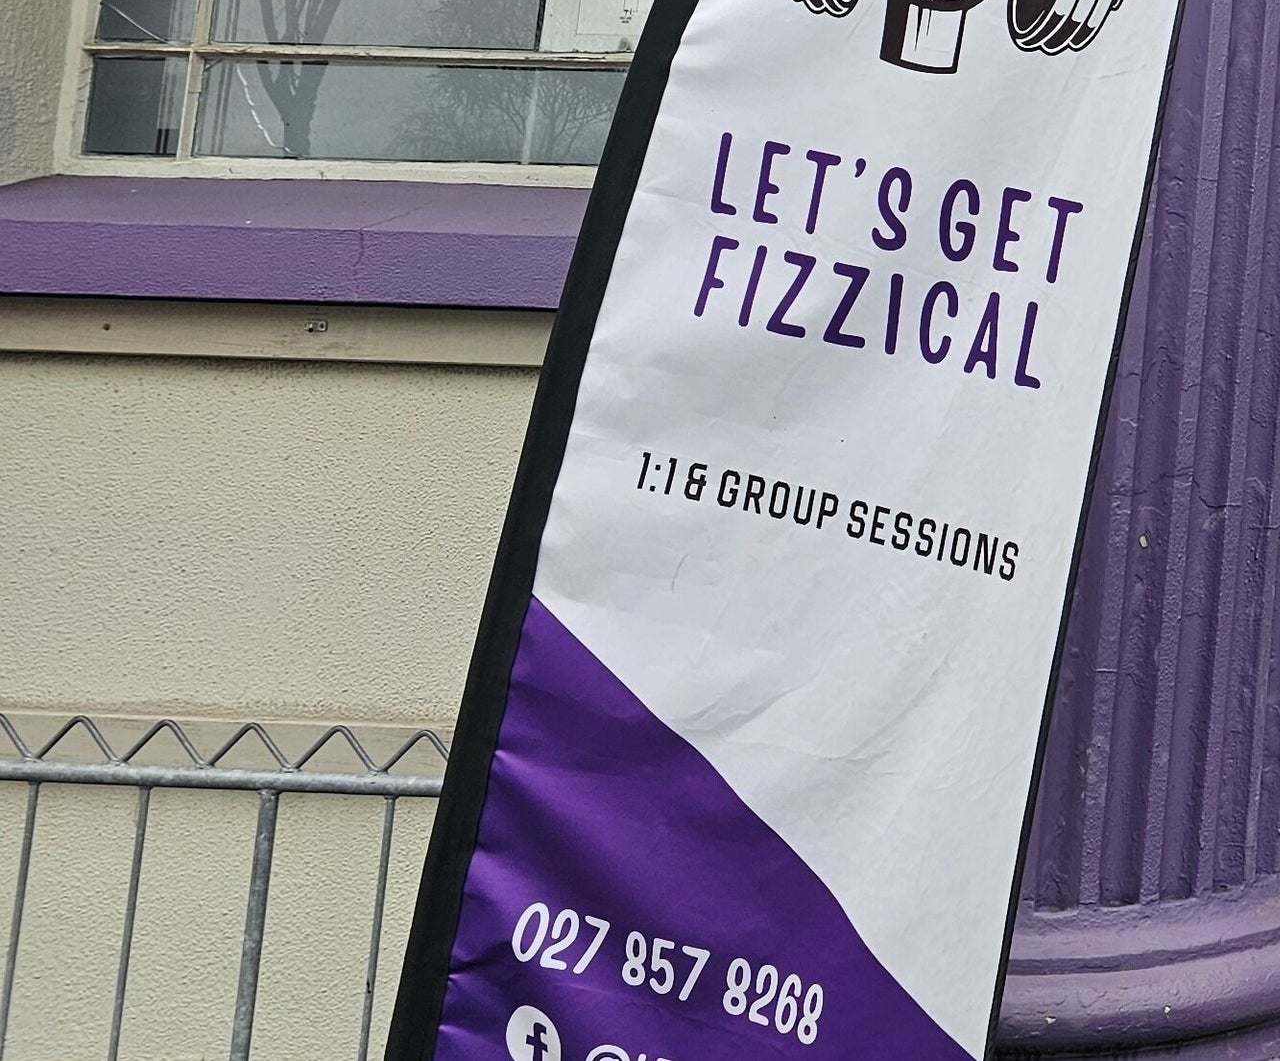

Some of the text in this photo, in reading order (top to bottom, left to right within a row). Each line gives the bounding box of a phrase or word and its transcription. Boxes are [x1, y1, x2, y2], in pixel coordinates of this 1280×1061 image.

[710, 132, 1084, 284] LET'S GET
[693, 234, 1042, 390] FIZZICAL
[635, 451, 1020, 583] 1:1 & GROUP SESSIONS
[511, 901, 824, 1046] 027 857 8268
